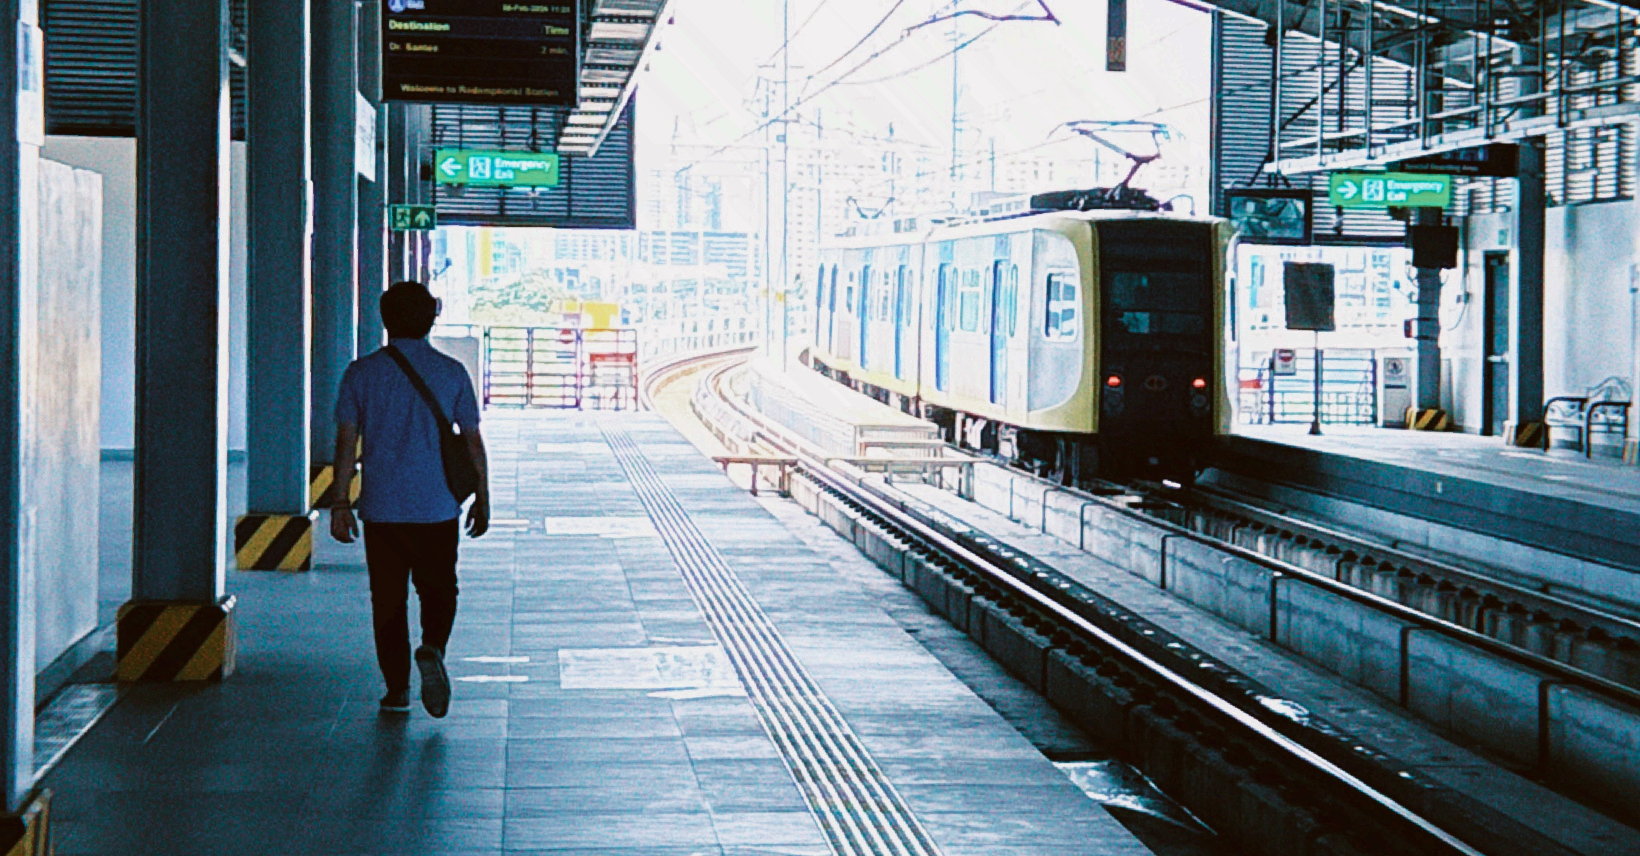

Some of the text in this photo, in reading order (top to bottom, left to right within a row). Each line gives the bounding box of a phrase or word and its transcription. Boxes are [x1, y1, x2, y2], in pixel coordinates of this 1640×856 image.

[389, 19, 450, 30] Destination
[544, 25, 569, 34] Time
[400, 84, 444, 93] Welcome
[494, 157, 551, 172] Emergency
[494, 169, 515, 179] Exit
[1387, 179, 1444, 194] Emergency
[1387, 191, 1407, 201] Exit
